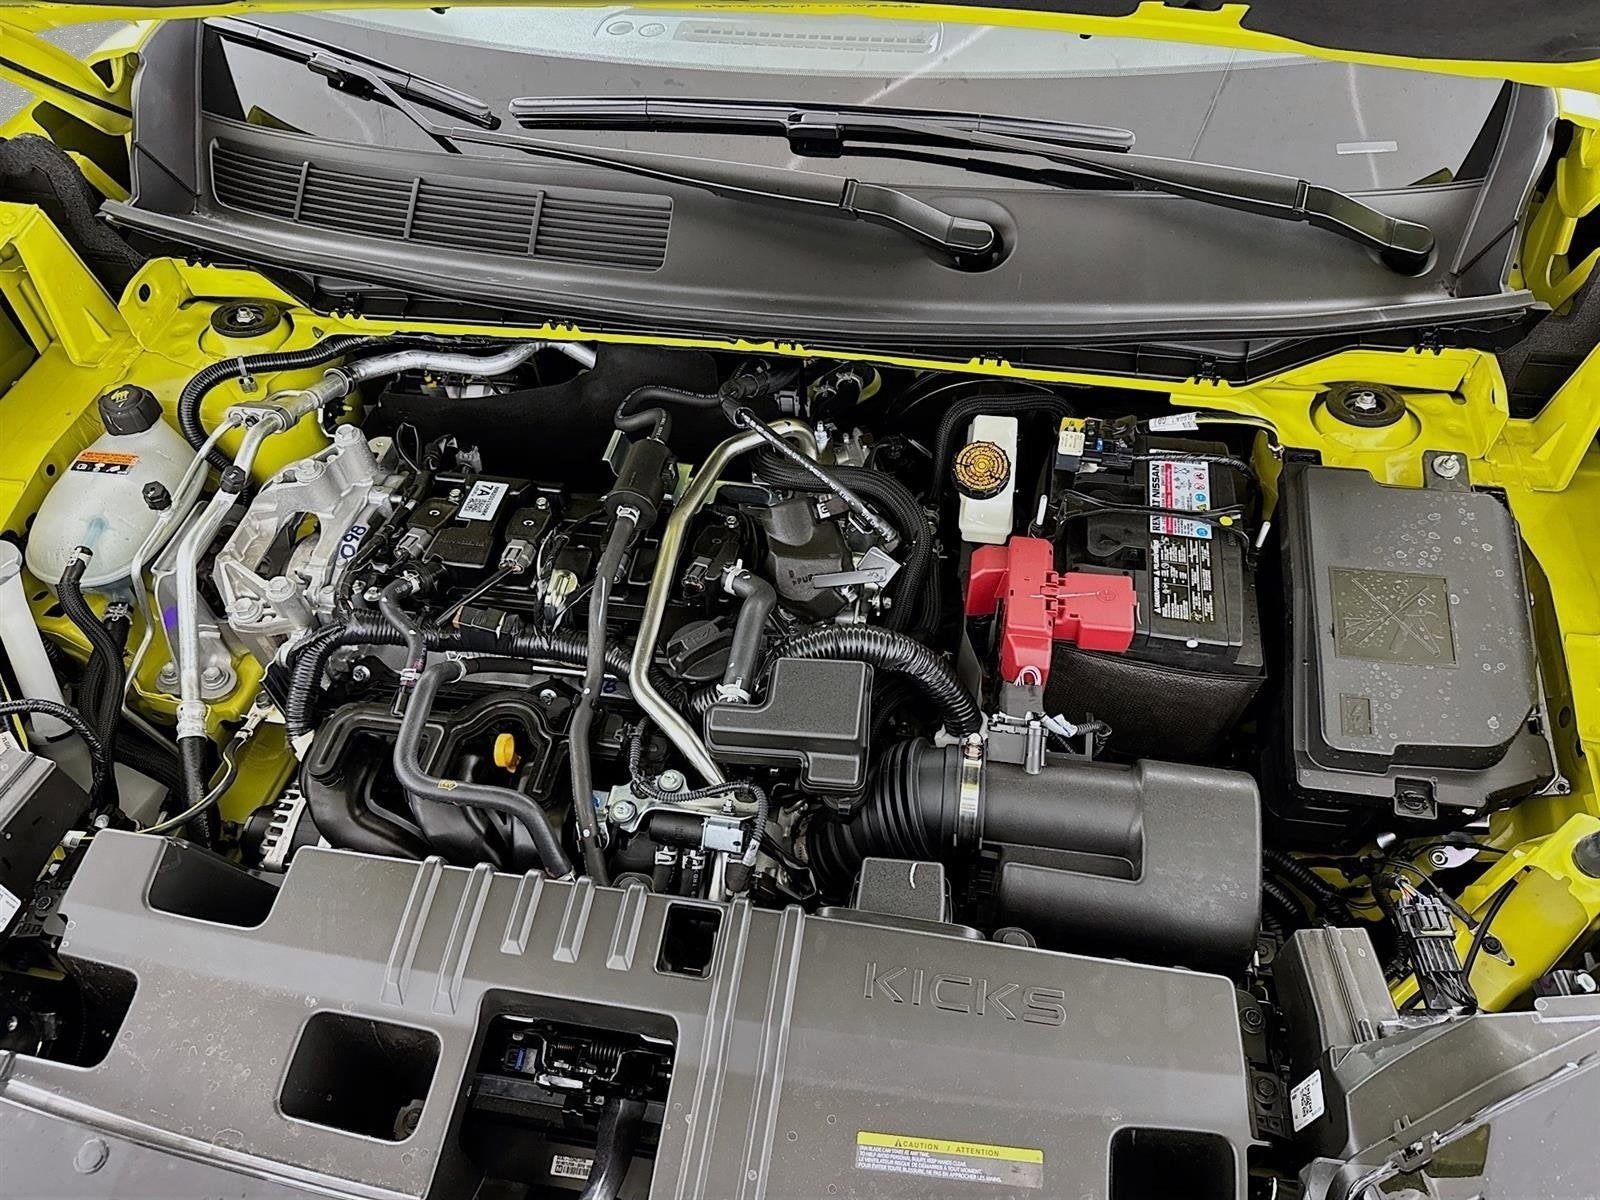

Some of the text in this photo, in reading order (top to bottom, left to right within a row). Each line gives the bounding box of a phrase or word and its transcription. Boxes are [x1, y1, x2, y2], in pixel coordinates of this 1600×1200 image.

[1152, 464, 1160, 498] NISSAN
[864, 962, 1066, 1026] KICKS
[902, 1140, 938, 1150] CAUTION
[956, 1146, 1000, 1157] ATTENTION
